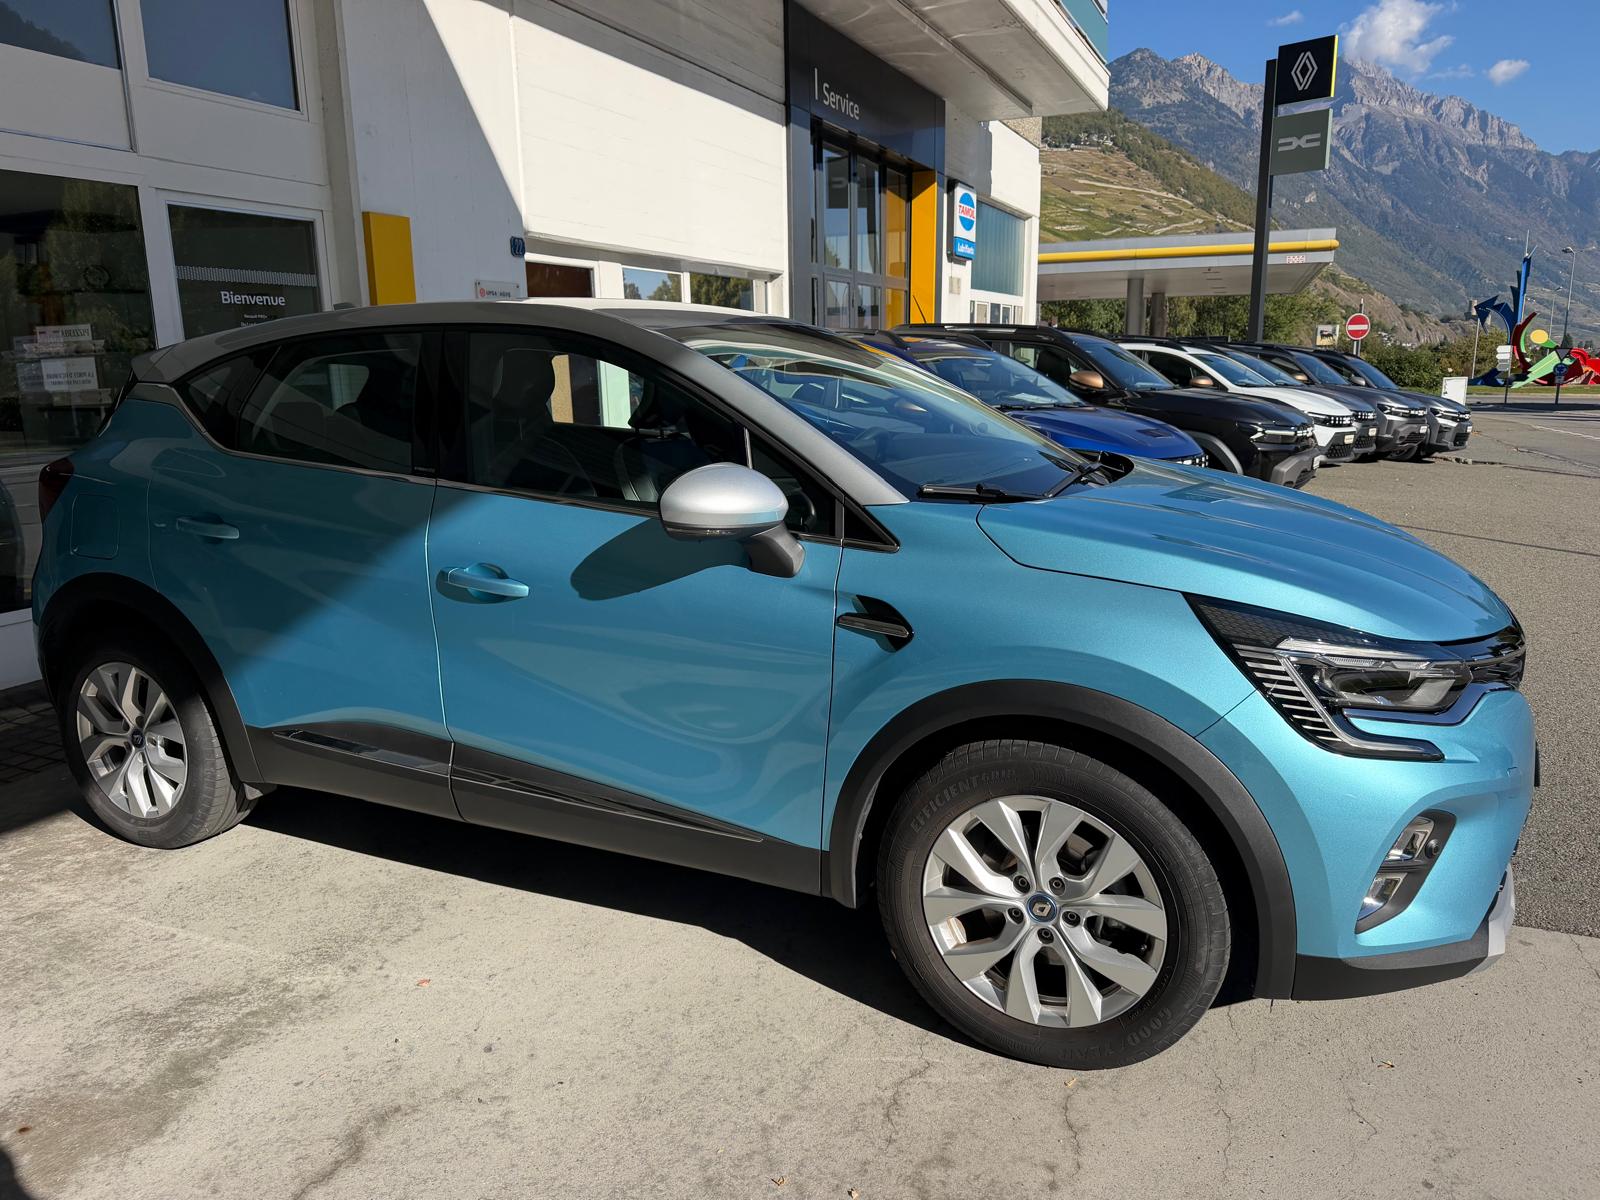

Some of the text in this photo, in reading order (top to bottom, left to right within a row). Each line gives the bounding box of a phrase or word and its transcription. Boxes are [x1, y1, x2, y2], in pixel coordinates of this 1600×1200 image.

[822, 82, 860, 120] Service
[958, 204, 976, 219] TAMOIL
[514, 238, 523, 254] 22
[220, 290, 287, 306] Bienvenue
